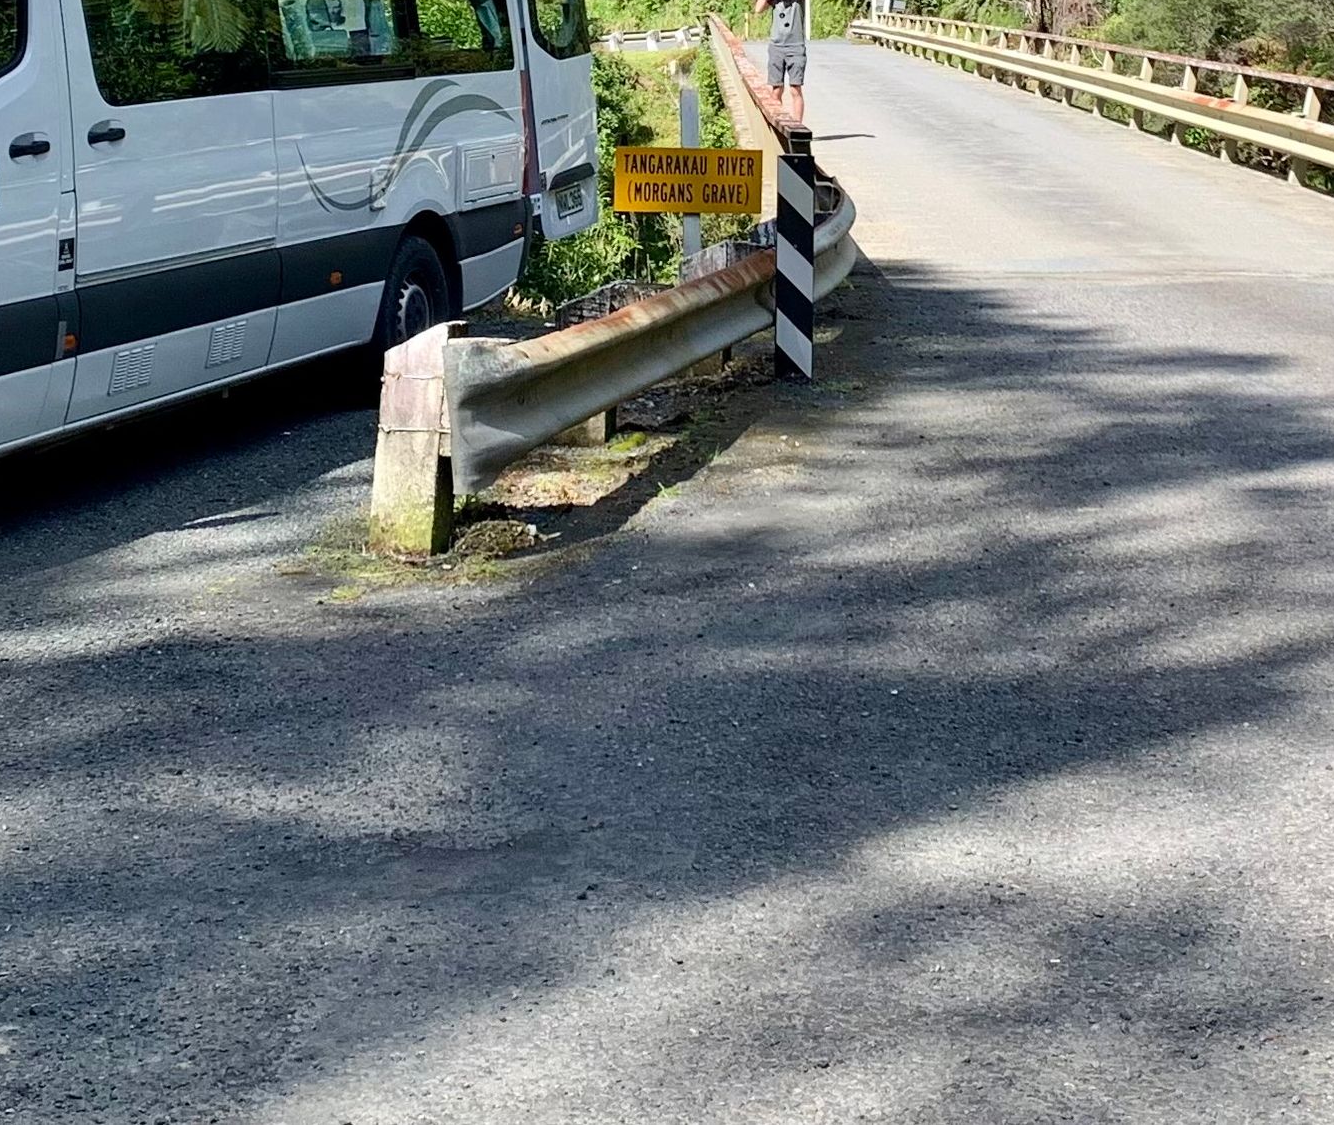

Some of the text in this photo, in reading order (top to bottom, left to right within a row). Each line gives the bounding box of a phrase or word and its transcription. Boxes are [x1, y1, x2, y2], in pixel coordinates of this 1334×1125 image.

[624, 154, 755, 177] TANGARAKAU RIVER
[627, 180, 750, 206] (MORGANS GRAVE)
